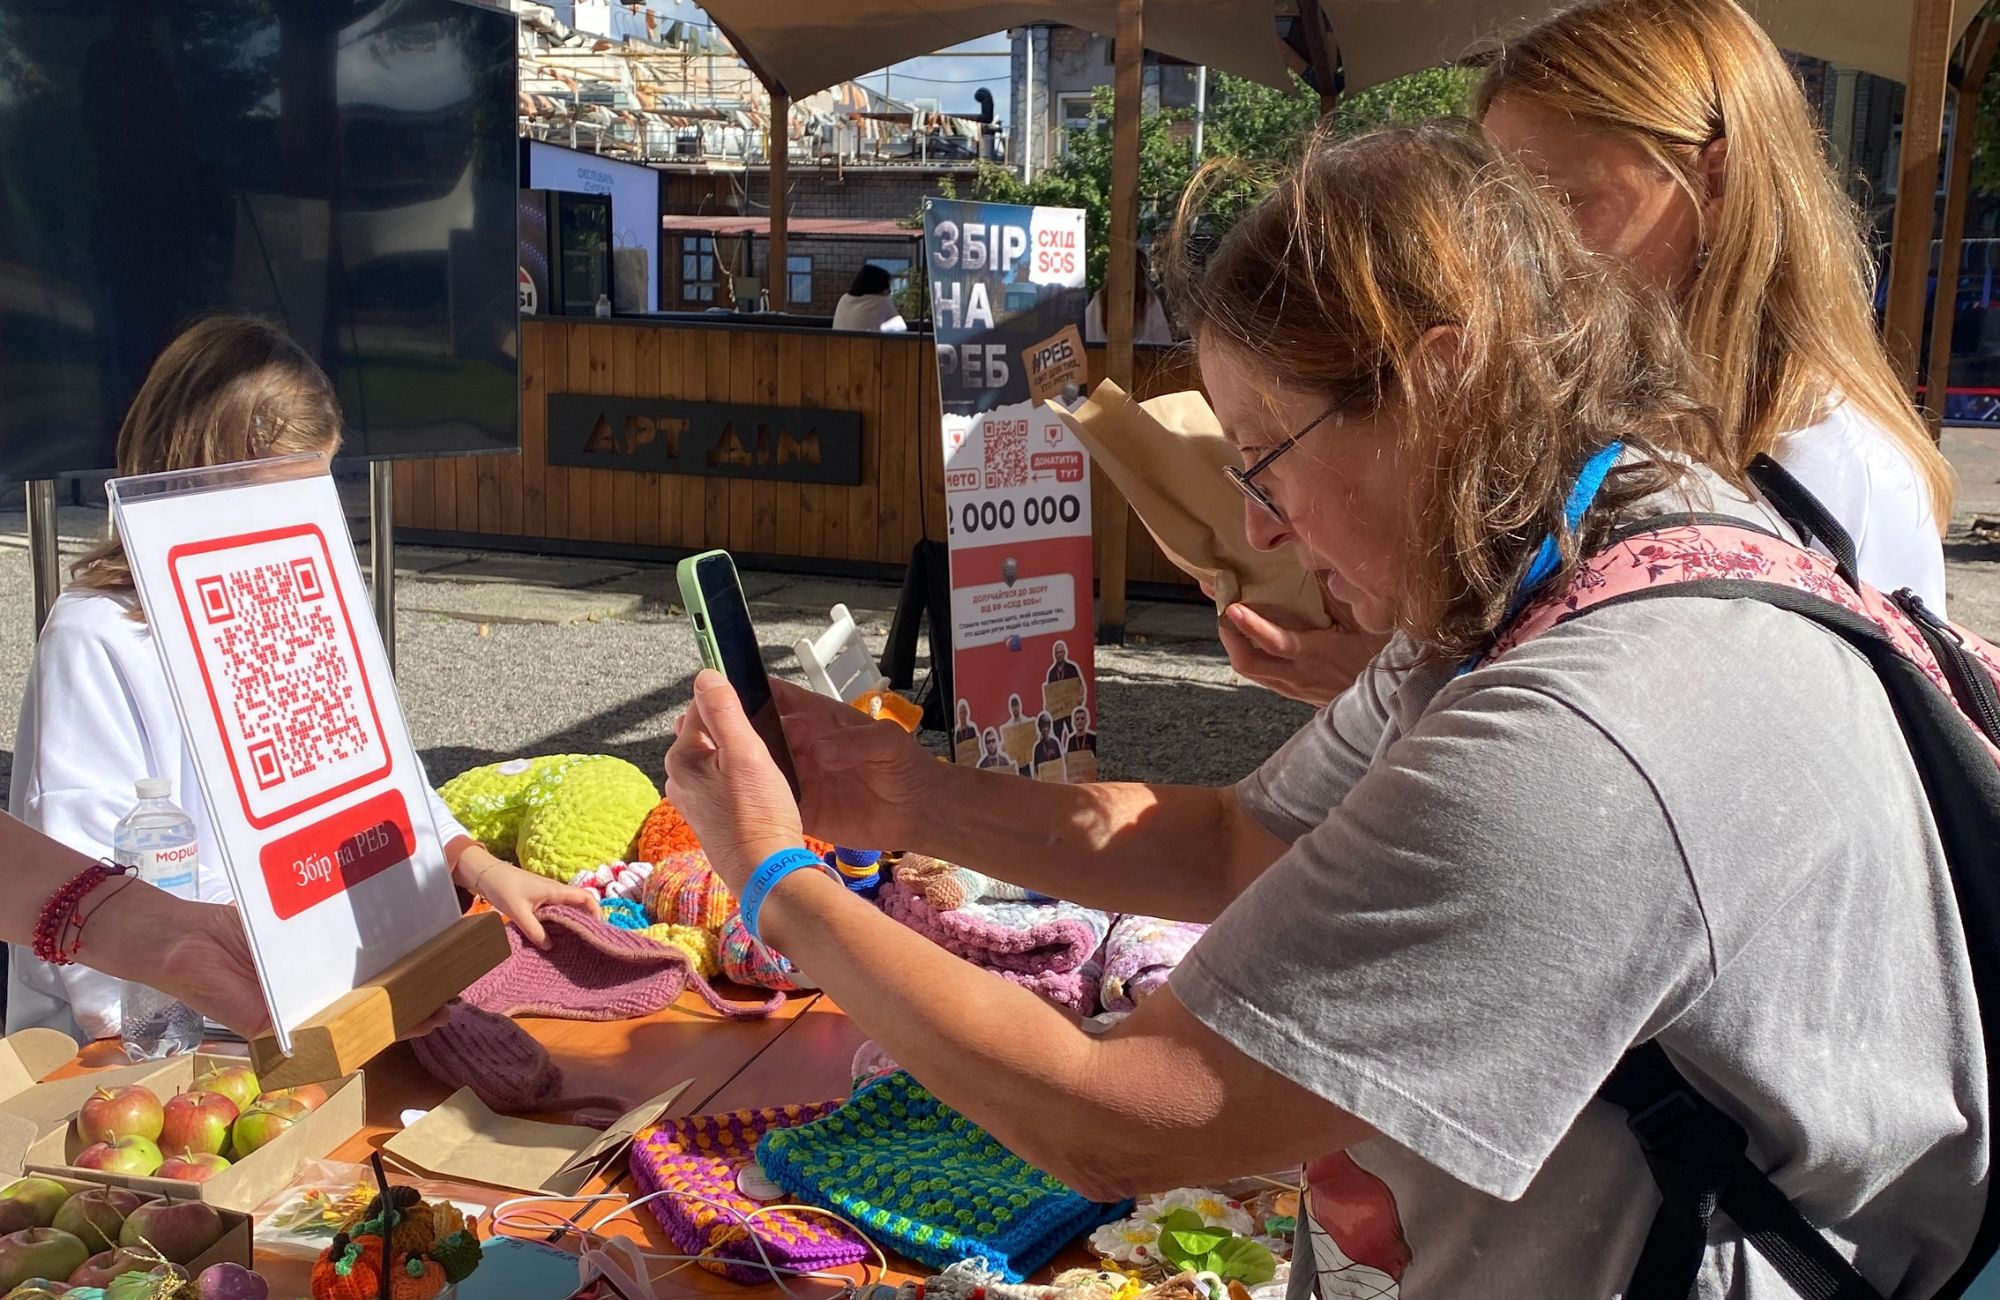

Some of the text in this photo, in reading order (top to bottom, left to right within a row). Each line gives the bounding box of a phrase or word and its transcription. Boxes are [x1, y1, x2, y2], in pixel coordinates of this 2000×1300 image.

[933, 221, 1027, 272] ЗБІР
[1038, 230, 1076, 249] СХІД
[1038, 251, 1075, 274] SOS
[933, 281, 995, 329] НА
[936, 344, 1010, 389] РЕБ
[583, 411, 690, 458] АРТ
[1033, 455, 1079, 467] ДОНАТИТИ
[1060, 469, 1079, 479] ТУТ
[963, 499, 1015, 533] 000
[1024, 494, 1080, 526] 000
[292, 823, 390, 887] Збір на РЕБ
